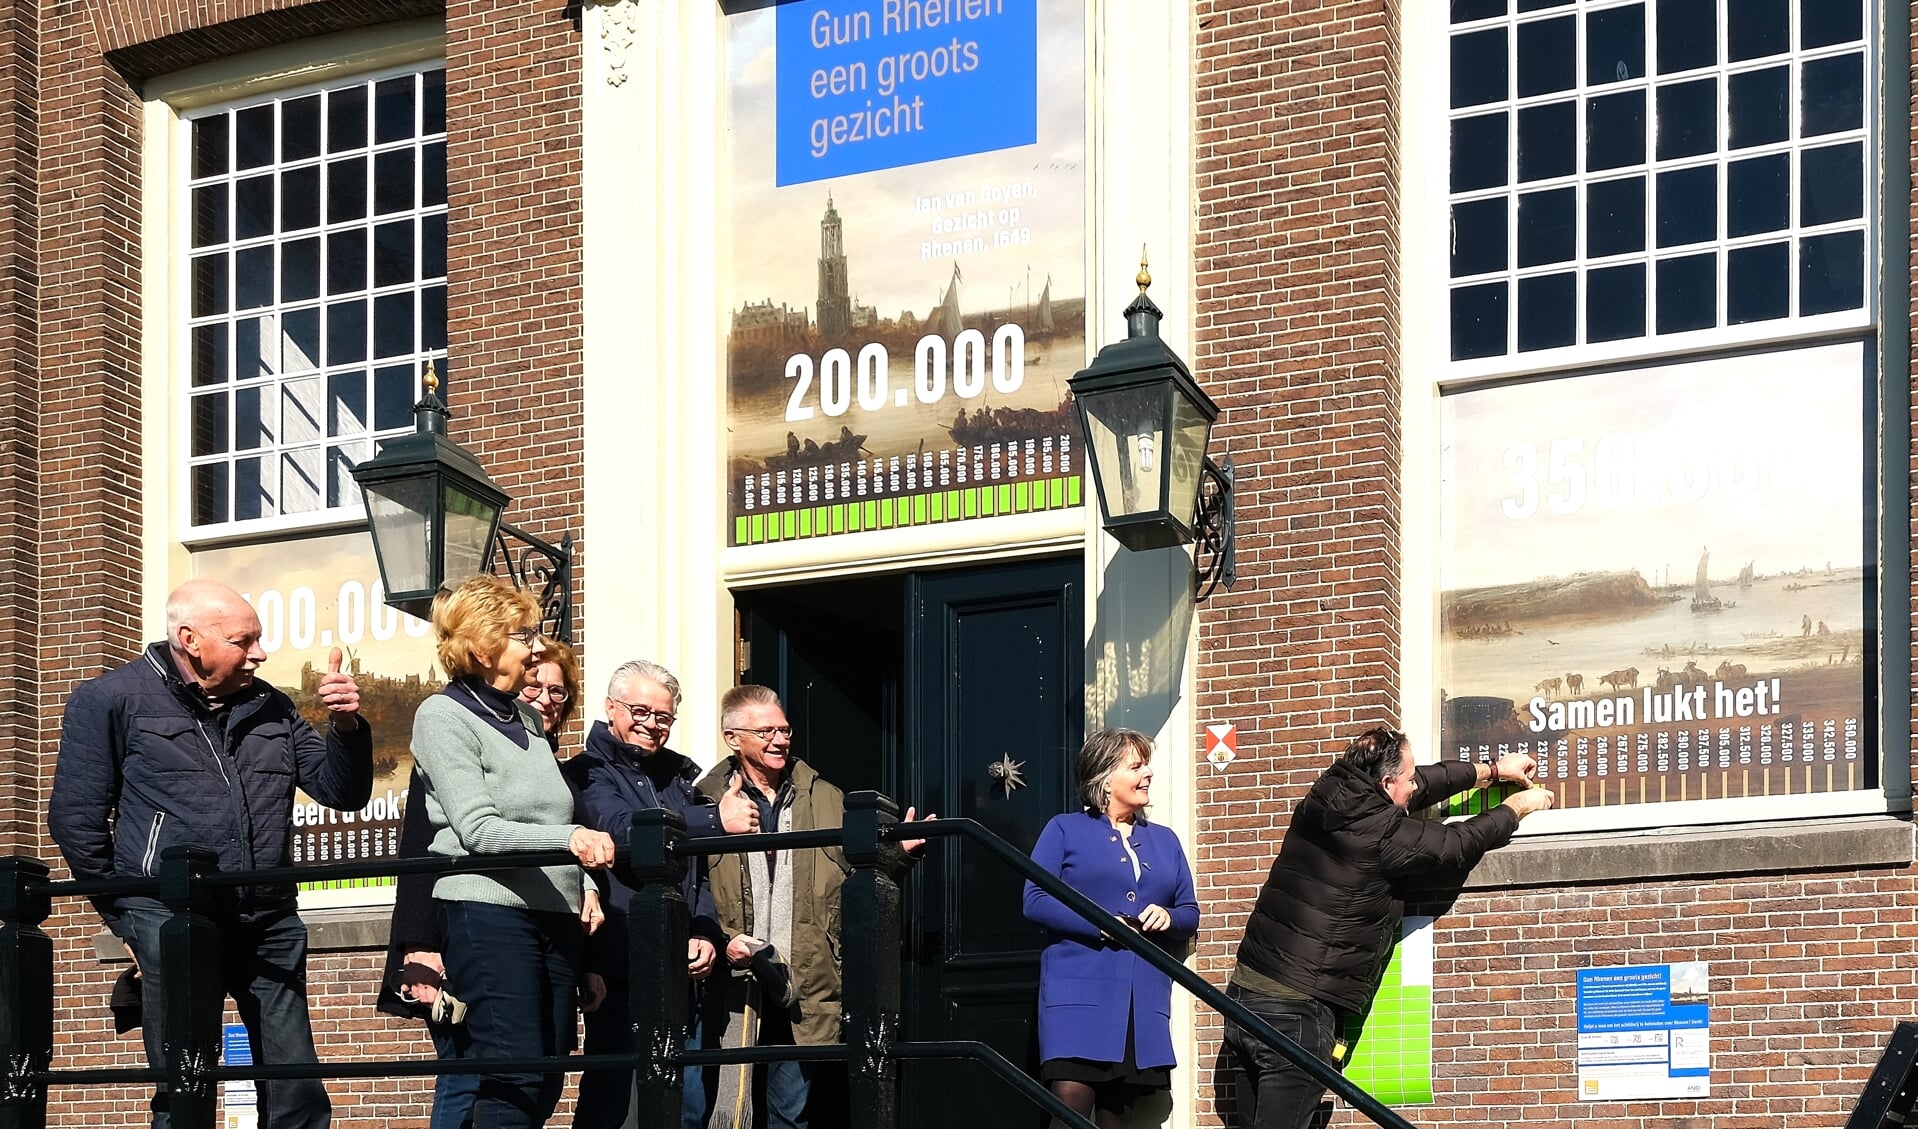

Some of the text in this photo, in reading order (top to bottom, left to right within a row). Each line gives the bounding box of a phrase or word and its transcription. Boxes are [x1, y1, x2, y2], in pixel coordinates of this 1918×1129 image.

[811, 10, 870, 48] Gun
[811, 38, 979, 98] een groots
[811, 95, 924, 158] gezicht
[914, 181, 1038, 215] Jan van Goyen,
[932, 208, 1020, 234] Gezicht op
[921, 227, 1031, 261] Rhenen, 1649
[783, 322, 1026, 422] 200.000
[923, 452, 933, 488] 160.000
[957, 447, 967, 483] 170.000
[974, 445, 984, 481] 175.000
[991, 443, 1001, 479] 180.000
[1008, 441, 1018, 477] 185.000
[1025, 439, 1035, 475] 190.000
[1043, 437, 1053, 473] 195.000
[1060, 434, 1070, 473] 200.000
[761, 473, 770, 506] 110.000
[777, 471, 786, 504] 115.000
[792, 469, 802, 504] 120.000
[808, 467, 818, 501] 125.000
[825, 464, 834, 499] 130.000
[841, 462, 851, 497] 135.000
[857, 460, 867, 496] 140.000
[873, 458, 883, 494] 145.000
[890, 456, 900, 492] 150.000
[906, 454, 916, 490] 155.000
[745, 475, 755, 510] 105.000
[1529, 678, 1781, 733] Samen lukt het!
[1577, 737, 1588, 777] 252.500
[1597, 736, 1608, 776] 260.000
[1617, 734, 1628, 773] 267.500
[1637, 733, 1648, 772] 275.000
[1657, 731, 1669, 771] 282.500
[1678, 730, 1689, 770] 290.000
[1698, 729, 1710, 767] 297.500
[1719, 727, 1730, 768] 305.000
[1739, 726, 1751, 764] 312.500
[1760, 724, 1772, 764] 320.000
[1781, 723, 1793, 762] 327.500
[1803, 721, 1814, 762] 335.000
[1824, 720, 1835, 760] 342.500
[1845, 718, 1856, 760] 350.000
[1537, 740, 1548, 778] 237.500
[1557, 739, 1568, 779] 245.000
[294, 834, 302, 862] 40.000
[307, 833, 315, 861] 45.000
[321, 832, 329, 861] 50.000
[334, 831, 342, 860] 55.000
[347, 830, 356, 859] 60.000
[361, 829, 369, 858] 65.000
[374, 828, 383, 856] 70.000
[388, 827, 397, 855] 75.000
